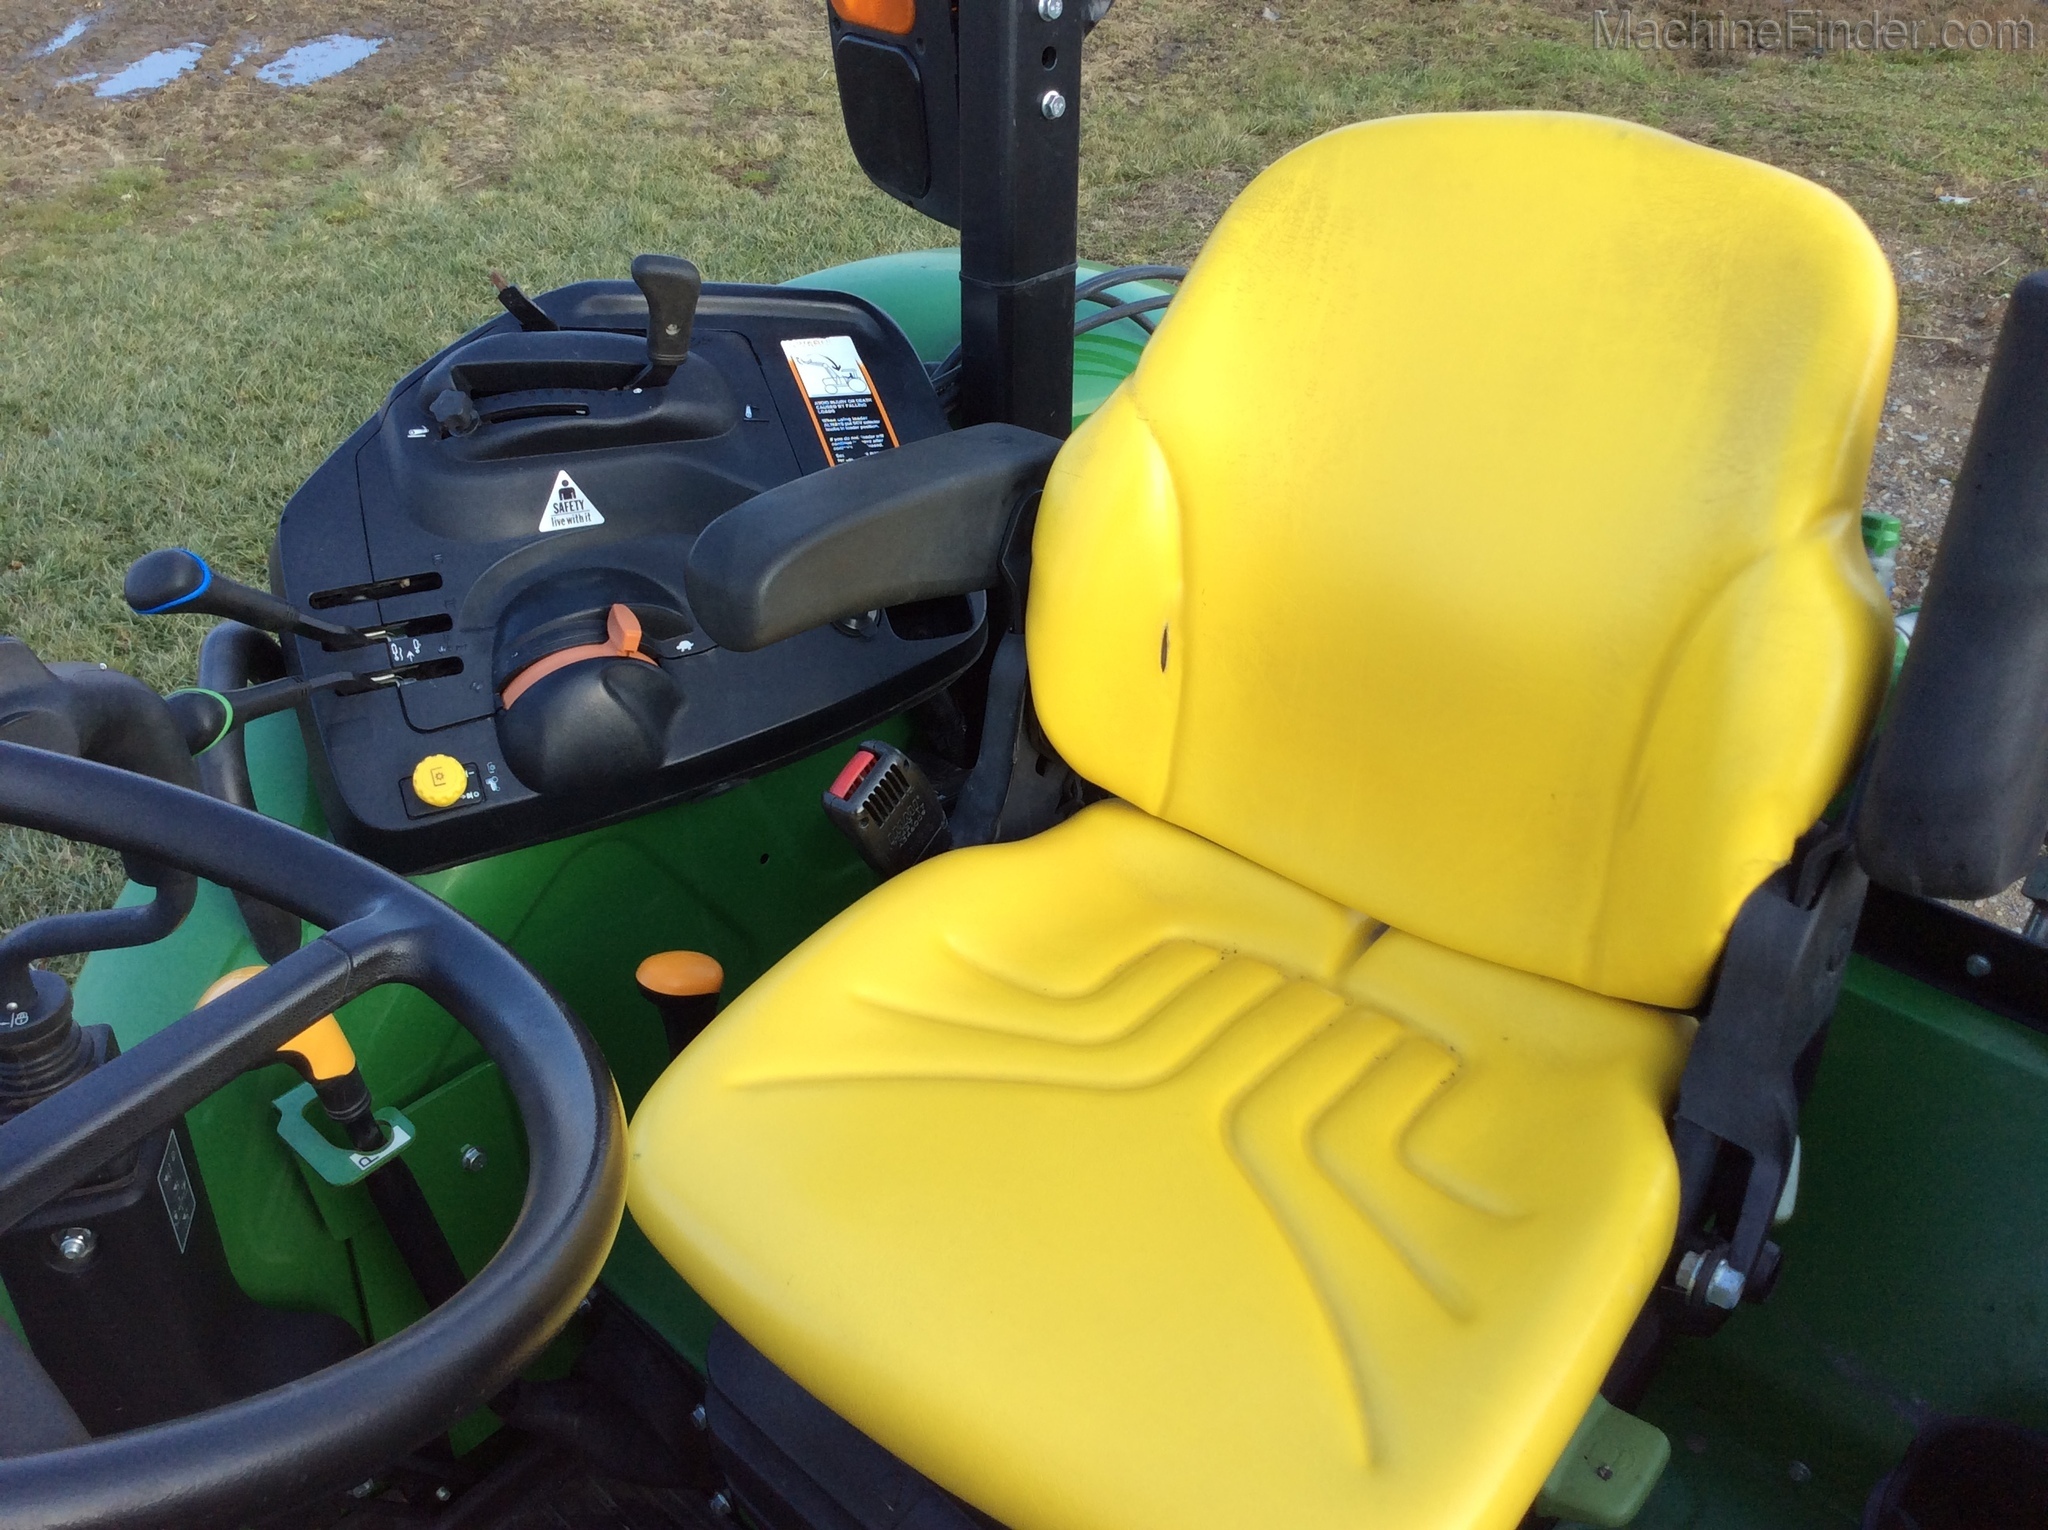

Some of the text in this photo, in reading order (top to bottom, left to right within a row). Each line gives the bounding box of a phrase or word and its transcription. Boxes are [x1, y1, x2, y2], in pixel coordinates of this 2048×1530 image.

[553, 500, 584, 514] SAFETY
[551, 512, 592, 527] live with it
[359, 1156, 380, 1168] P
